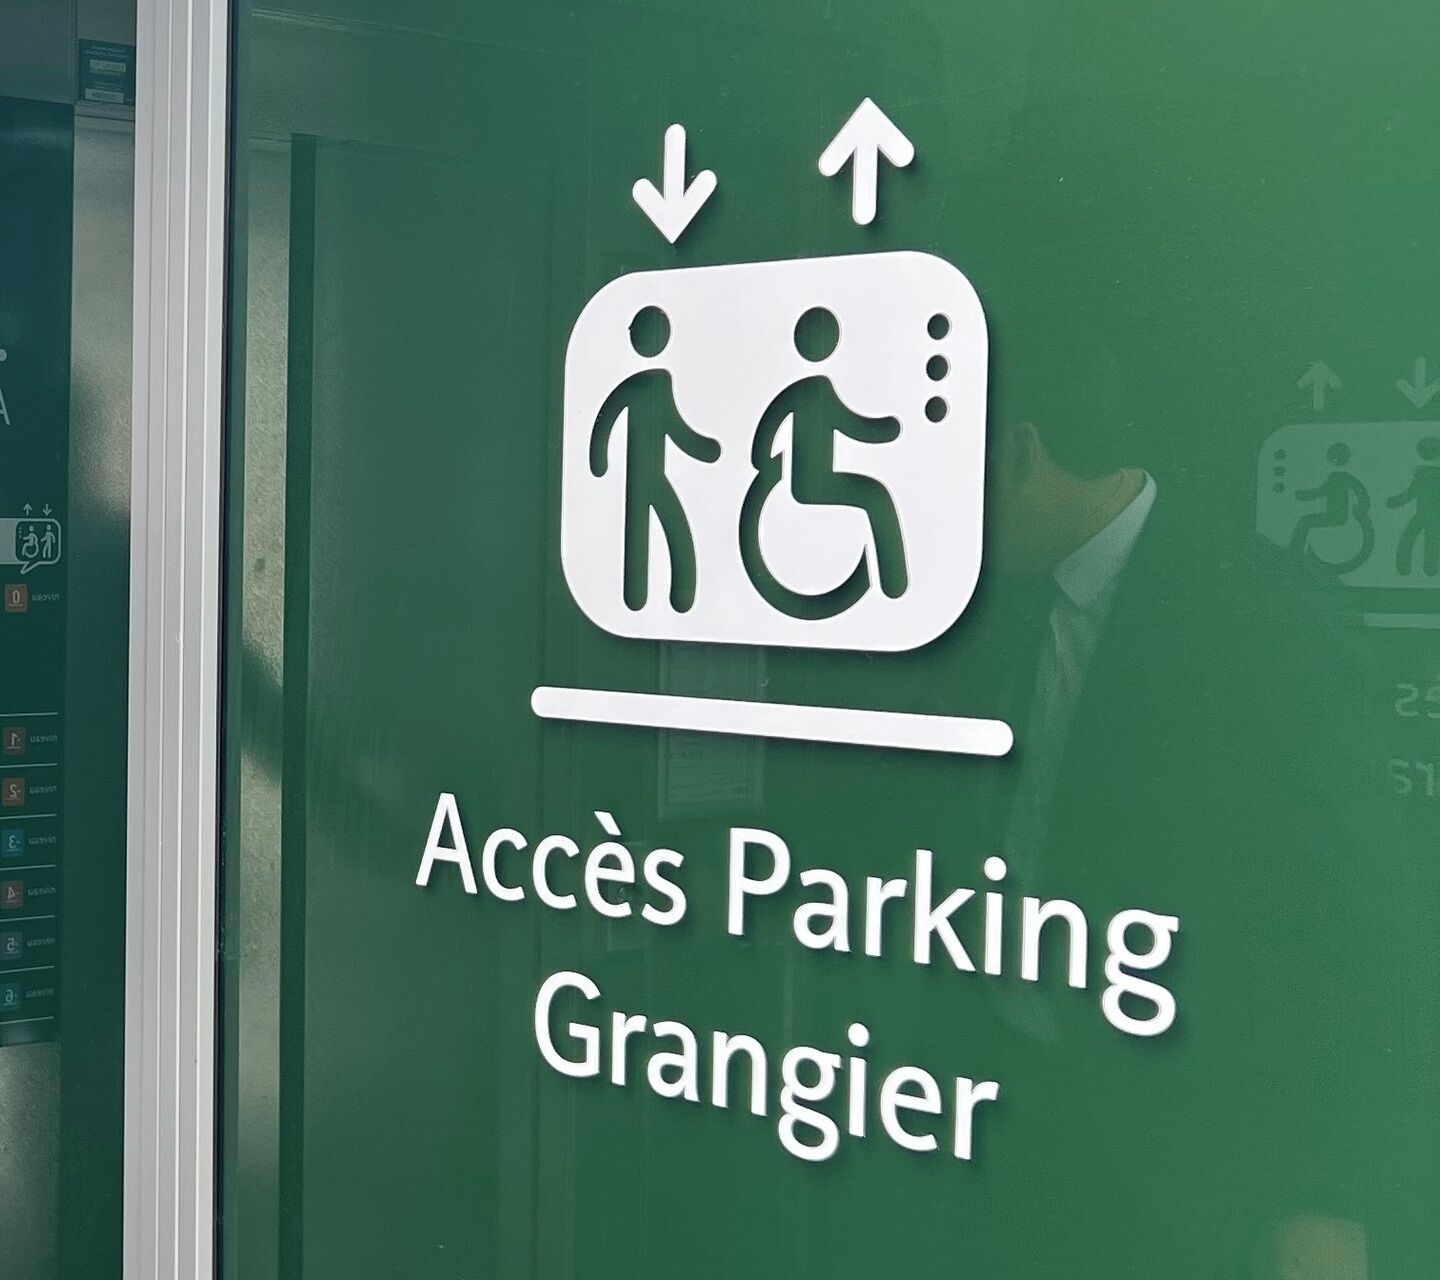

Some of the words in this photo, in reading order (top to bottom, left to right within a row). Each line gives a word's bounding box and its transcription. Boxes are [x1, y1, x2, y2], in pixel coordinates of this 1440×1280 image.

[416, 792, 687, 926] Accès
[728, 827, 1180, 1037] Parking
[534, 971, 1000, 1162] Grangier
